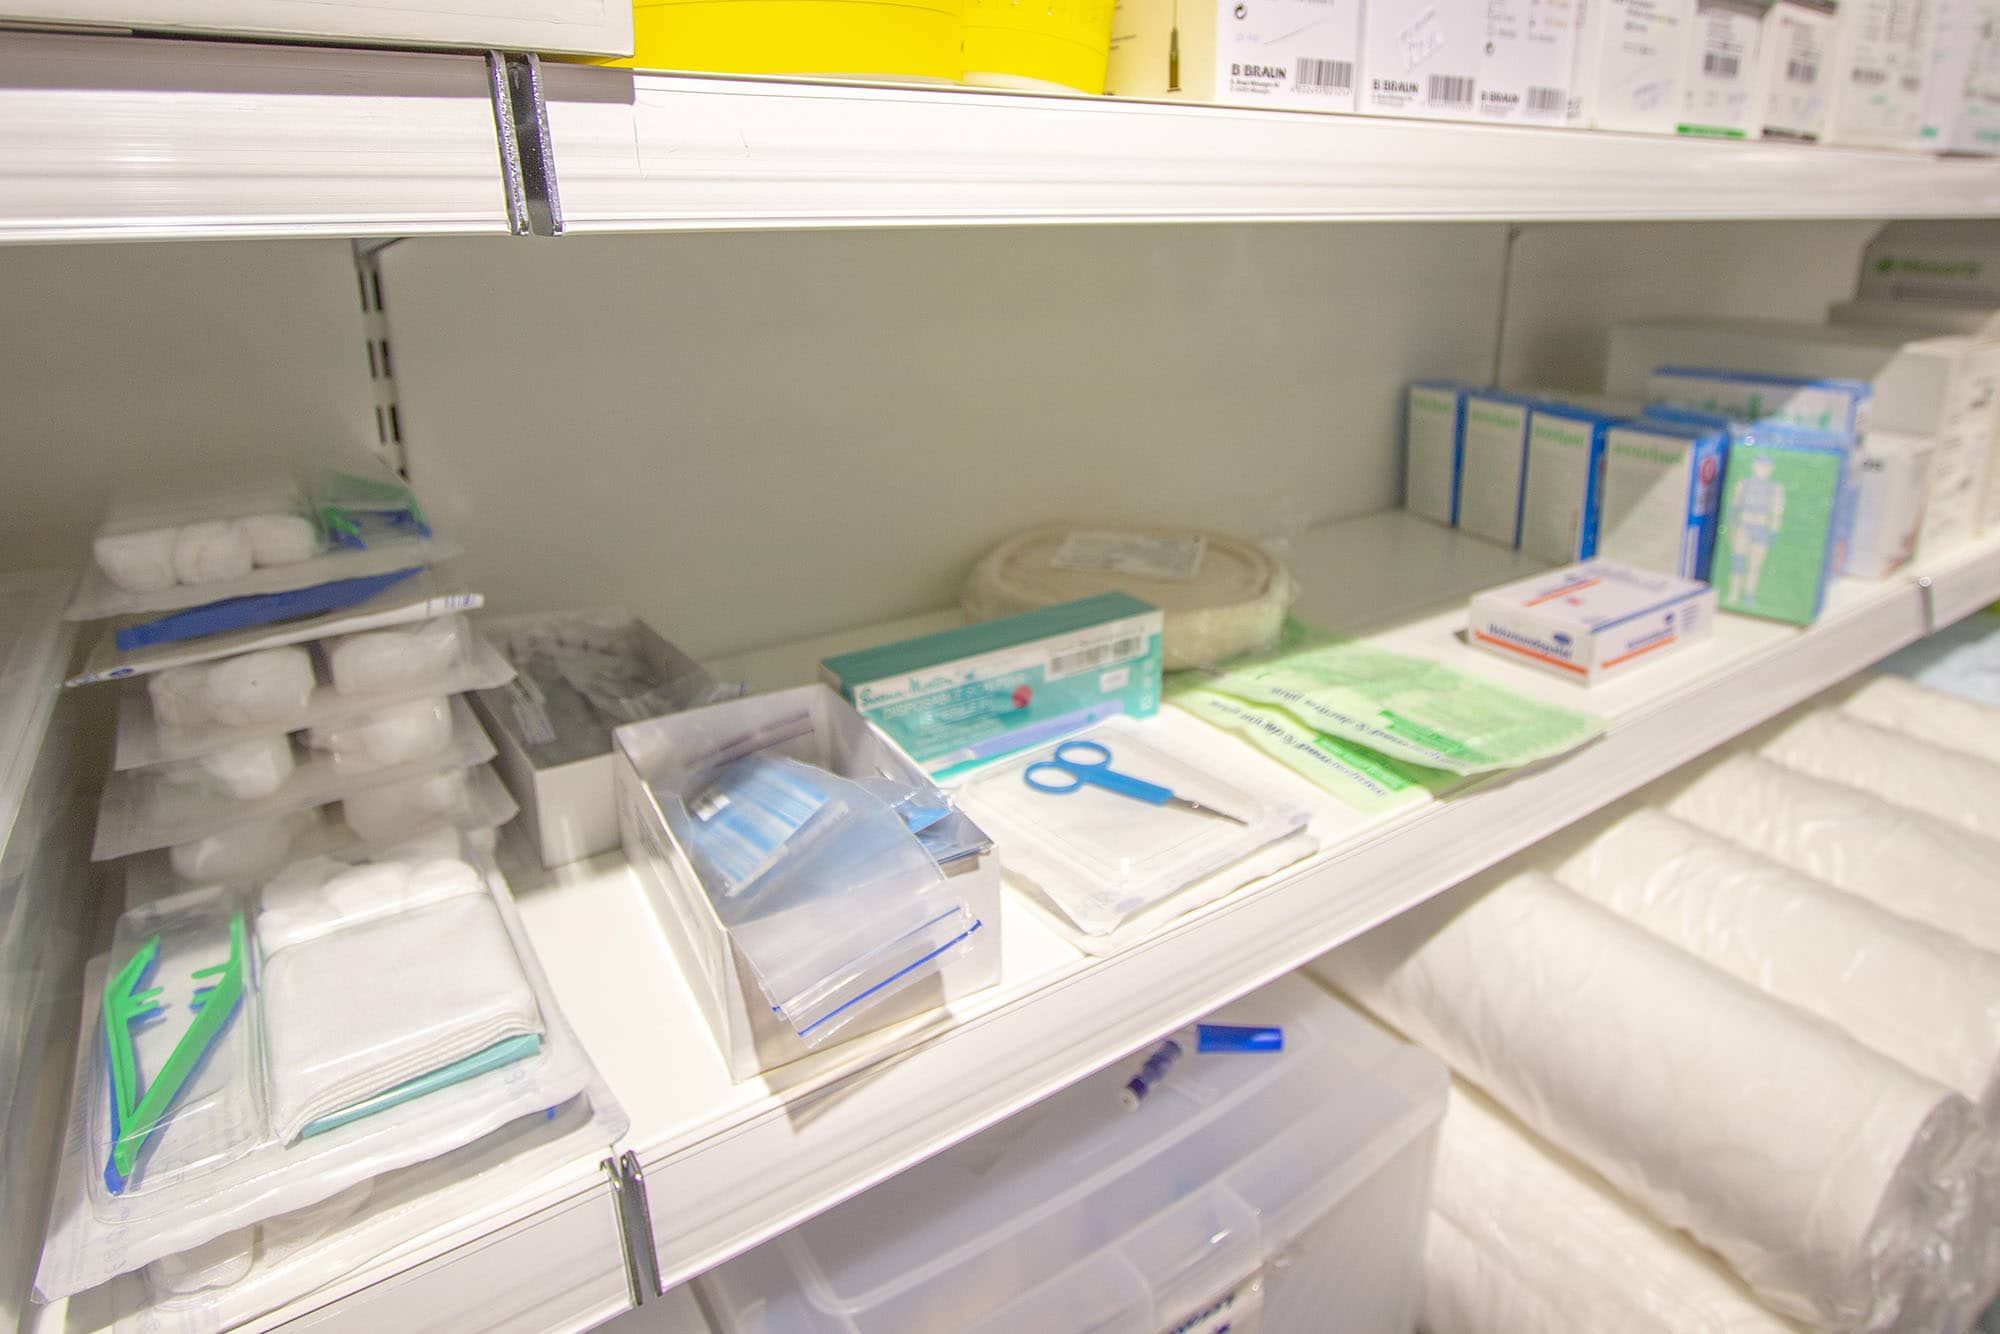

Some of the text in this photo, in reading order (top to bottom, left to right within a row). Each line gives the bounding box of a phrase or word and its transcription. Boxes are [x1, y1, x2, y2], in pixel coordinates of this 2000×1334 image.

[1231, 63, 1287, 79] B BRAUN
[1384, 79, 1420, 93] BRAUN
